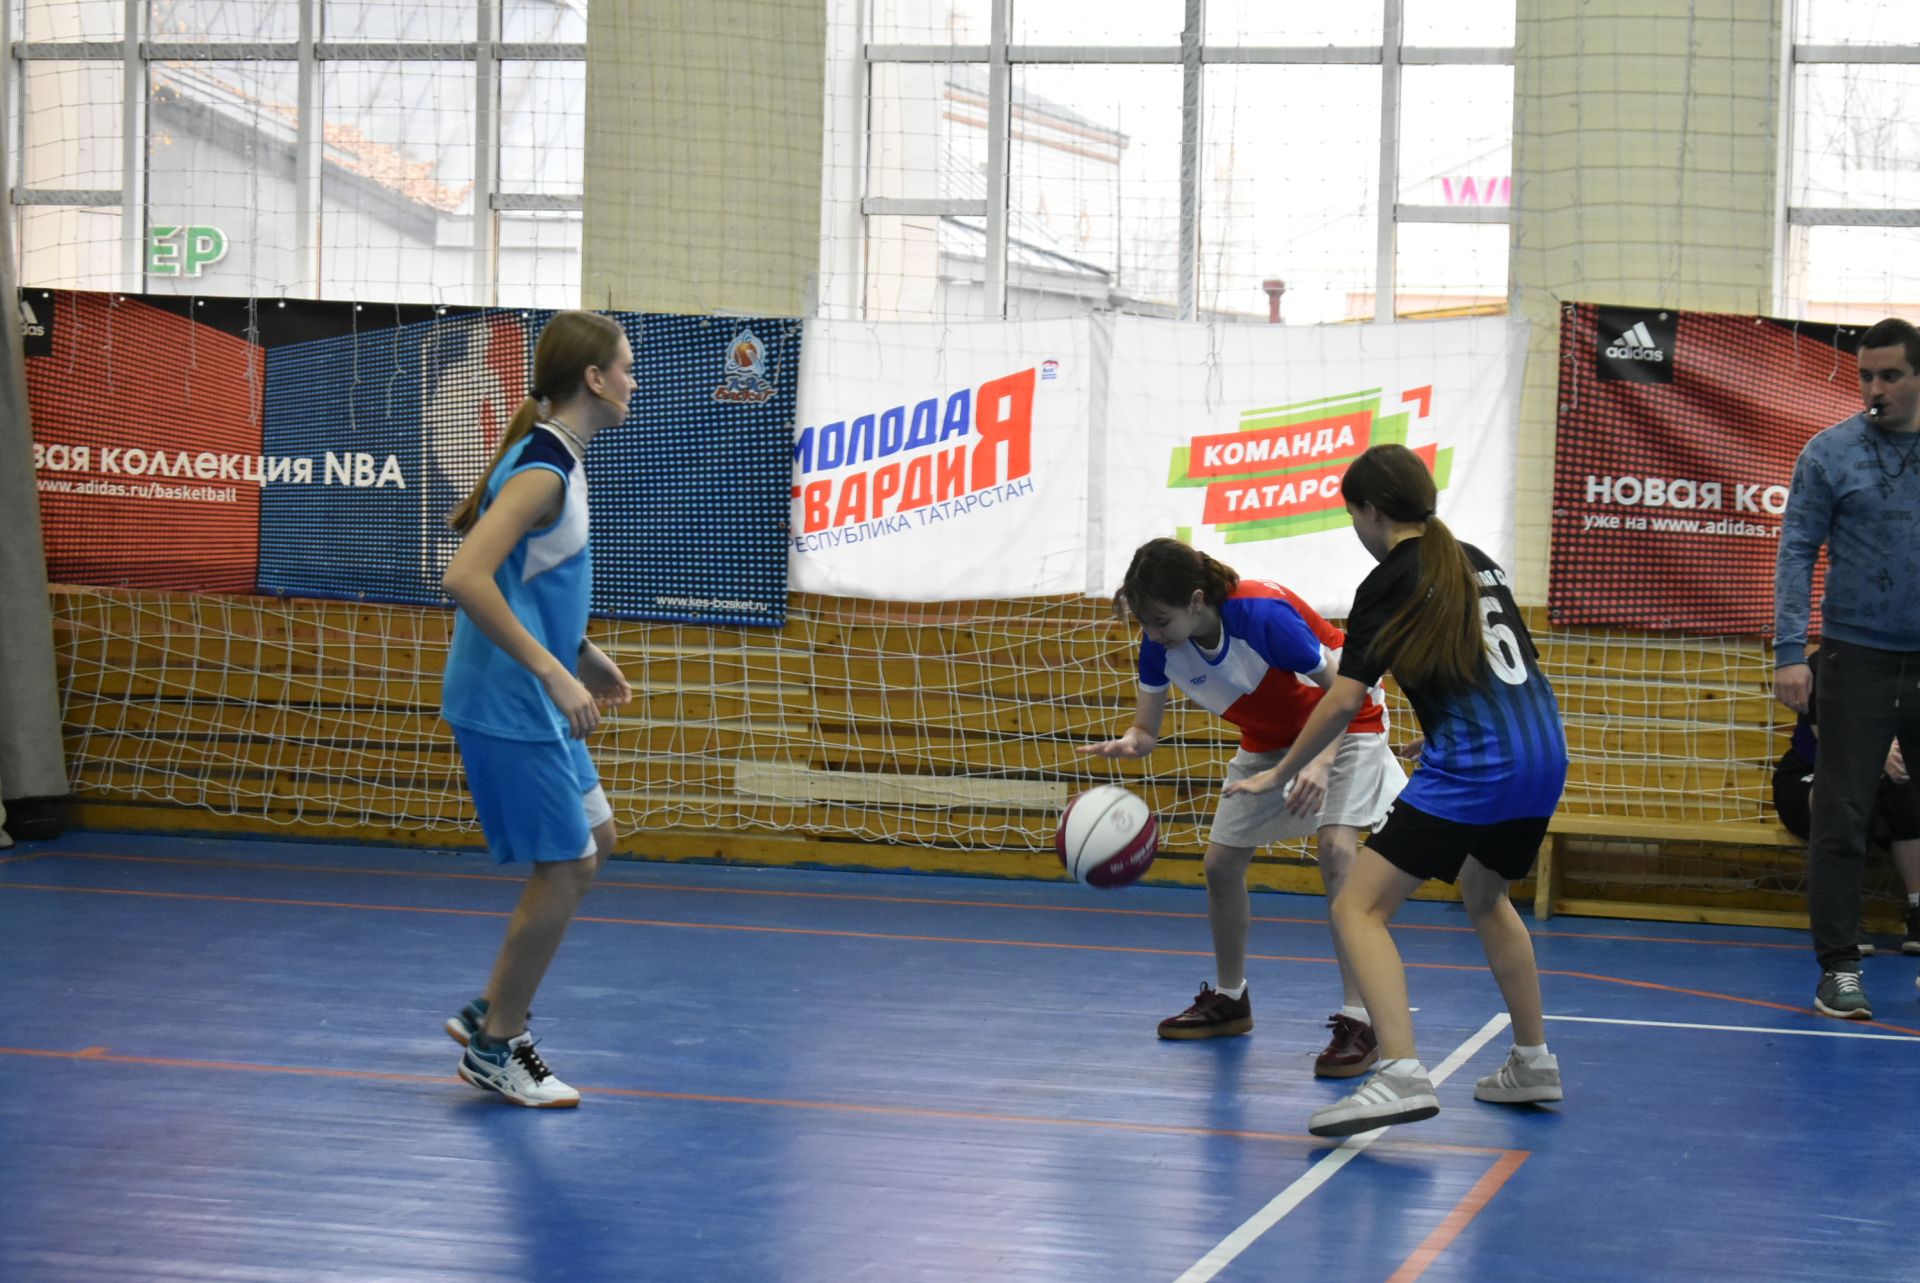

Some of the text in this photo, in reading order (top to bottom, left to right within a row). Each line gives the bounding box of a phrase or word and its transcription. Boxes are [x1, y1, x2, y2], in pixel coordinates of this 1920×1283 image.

[1605, 344, 1664, 362] adidas
[1203, 425, 1356, 468] КОМАНДА
[323, 451, 406, 489] NBA
[918, 477, 1034, 526] ТАТАРСТАН
[1224, 474, 1340, 512] ТАТАРС
[1583, 515, 1620, 531] уже
[1625, 518, 1647, 531] на
[656, 596, 767, 611] www.kes-basket.ru
[1479, 596, 1528, 685] 6
